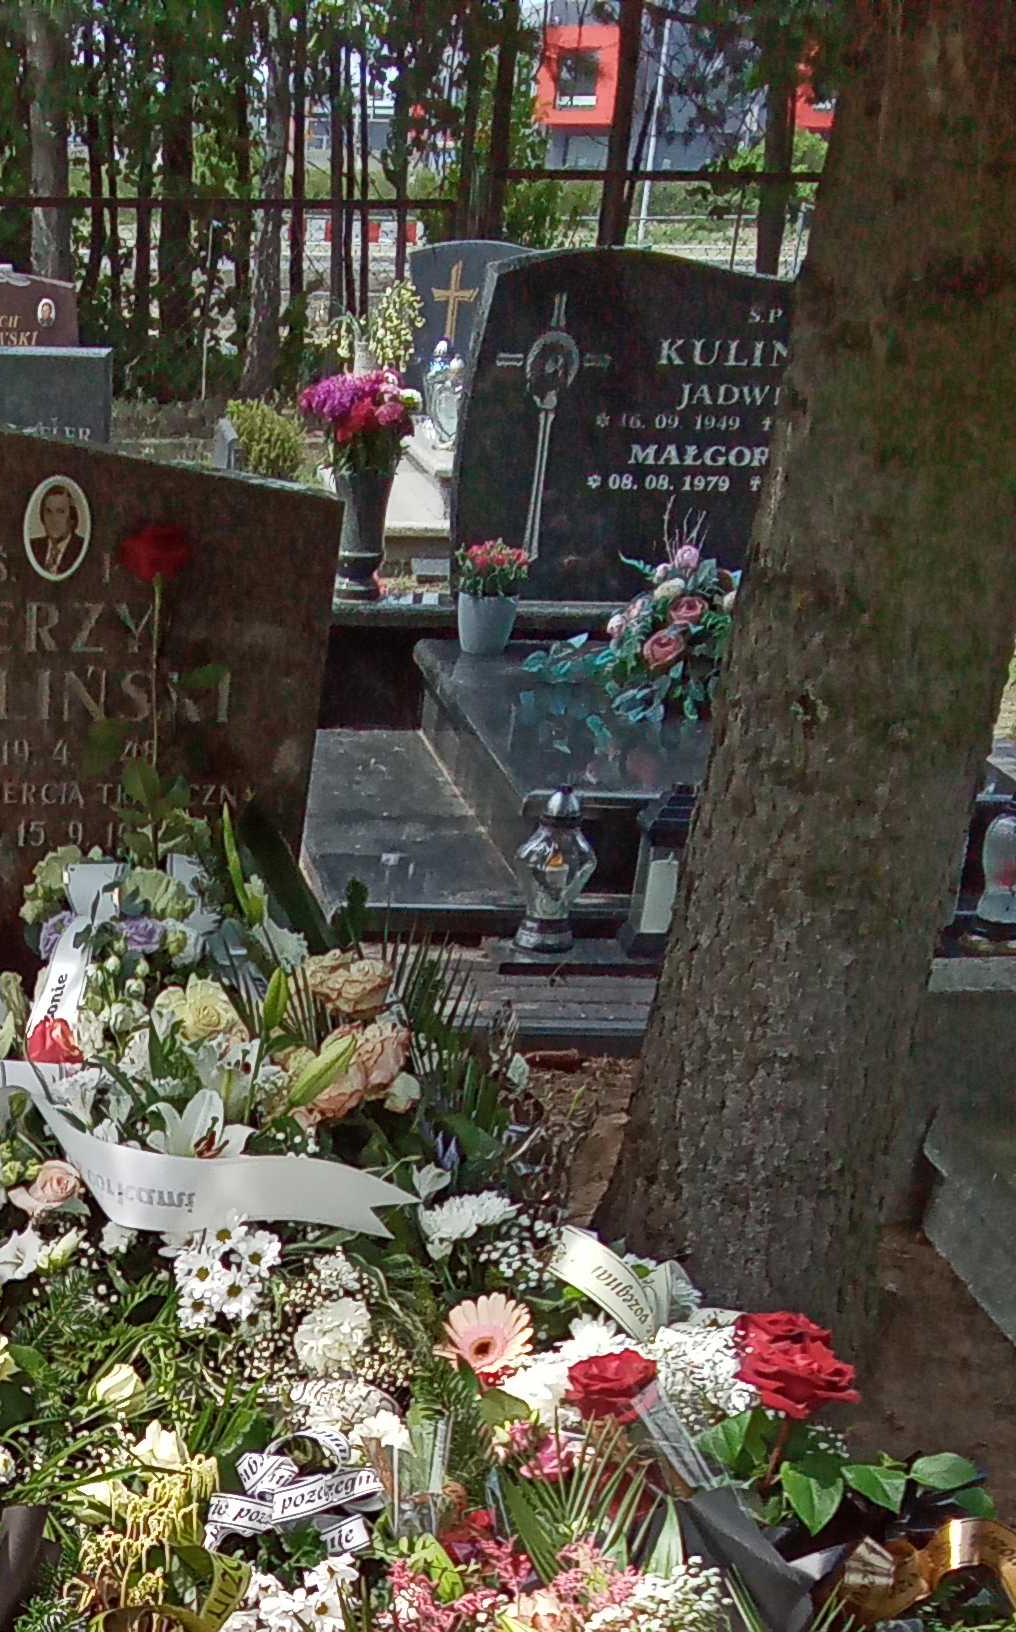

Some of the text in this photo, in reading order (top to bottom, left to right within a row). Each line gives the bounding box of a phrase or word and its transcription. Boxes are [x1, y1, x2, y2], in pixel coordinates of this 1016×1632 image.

[695, 413, 741, 431] 1949
[682, 475, 731, 492] 1979
[48, 972, 68, 1018] onie
